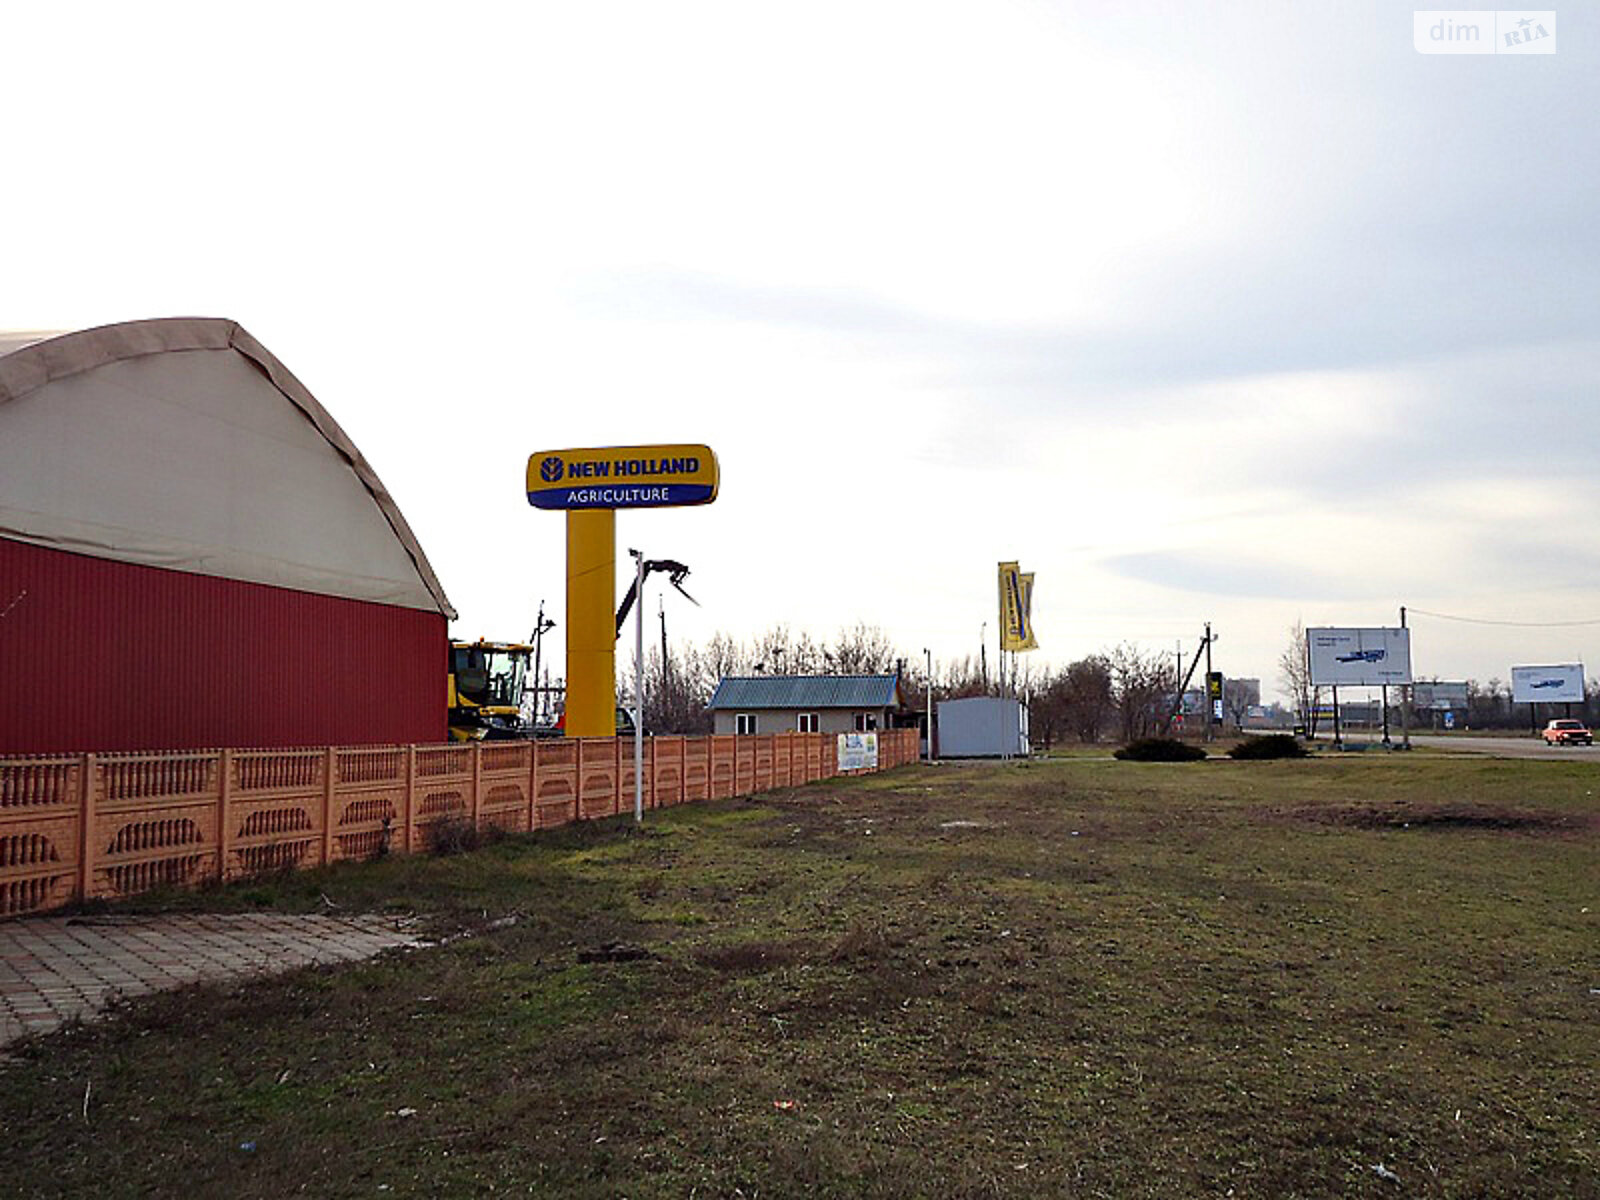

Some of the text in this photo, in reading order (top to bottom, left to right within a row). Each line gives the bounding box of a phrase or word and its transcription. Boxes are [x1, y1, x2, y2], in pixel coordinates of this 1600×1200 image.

[568, 457, 700, 478] NEW HOLLAND
[567, 487, 669, 503] AGRICULTURE
